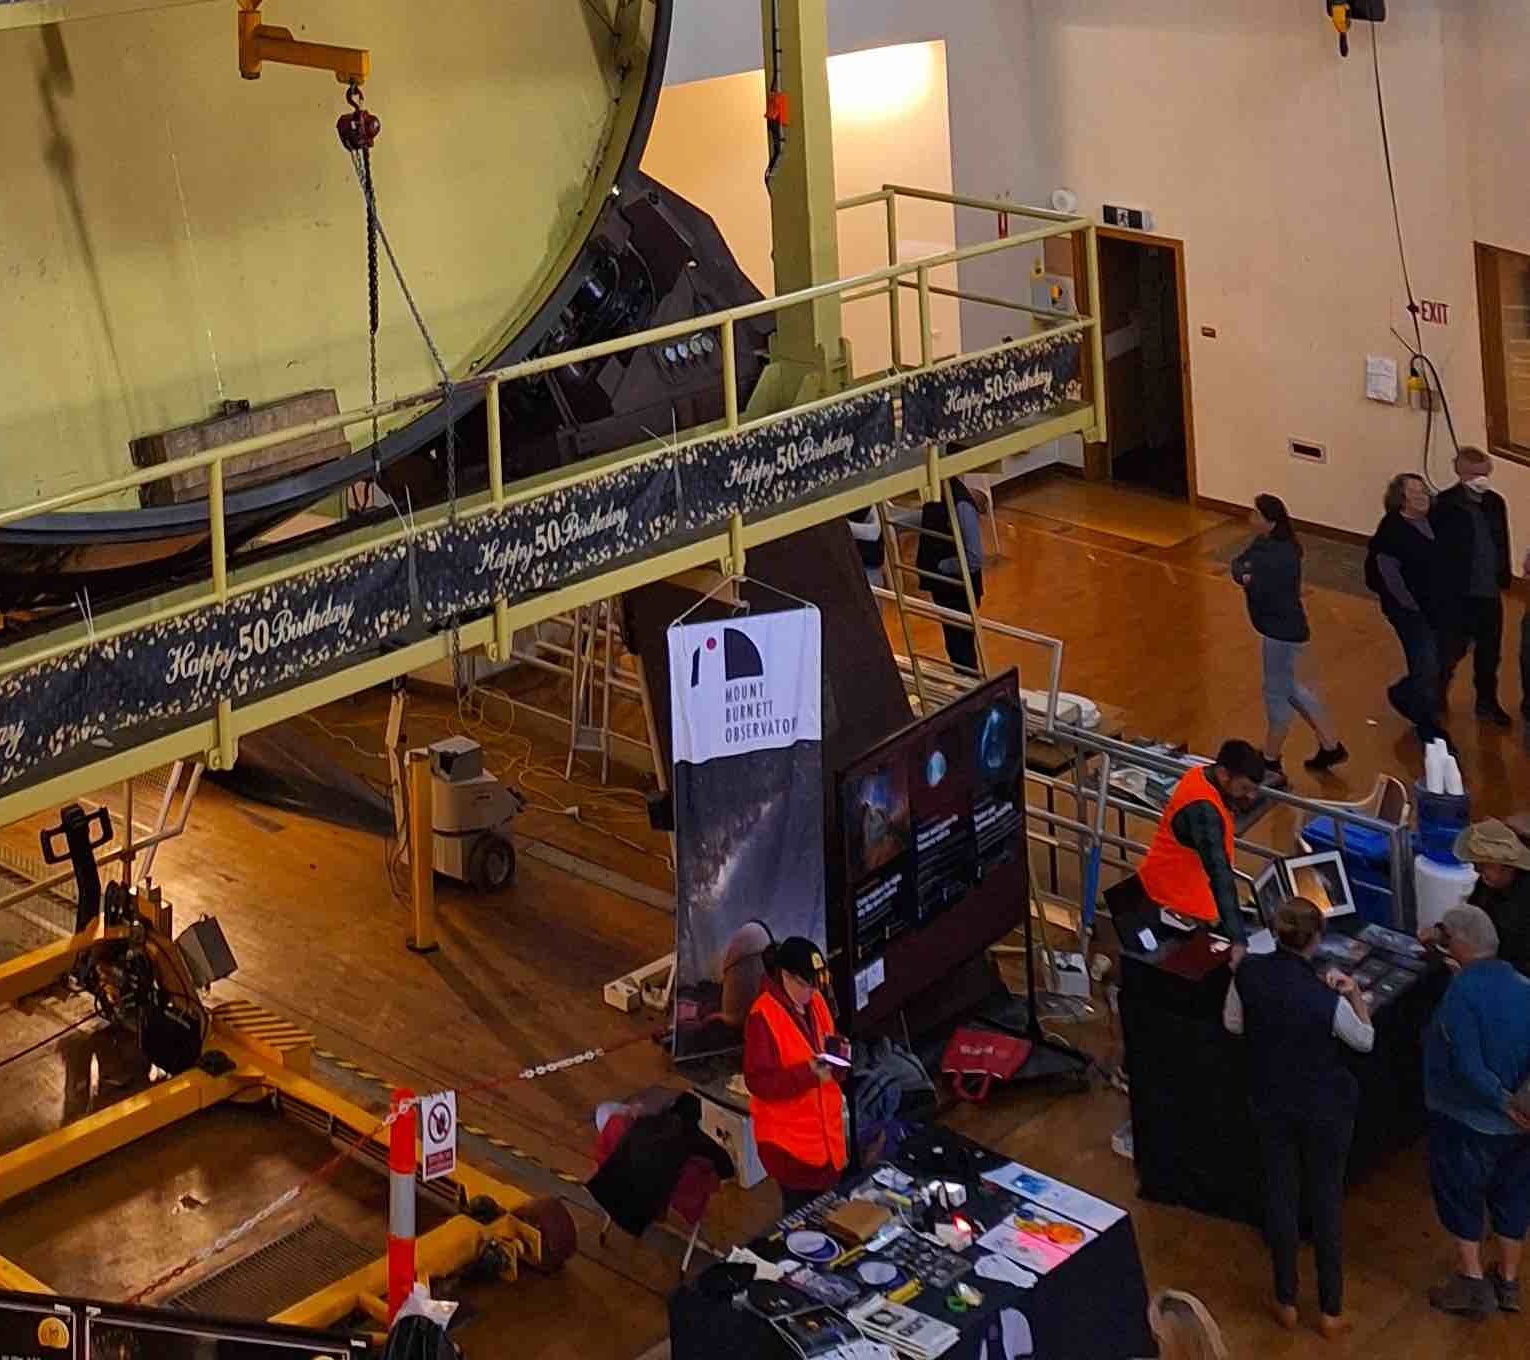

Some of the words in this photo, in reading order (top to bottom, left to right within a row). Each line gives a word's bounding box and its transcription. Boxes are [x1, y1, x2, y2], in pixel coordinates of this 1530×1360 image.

[1421, 300, 1449, 324] EXIT
[943, 384, 984, 420] Happy
[984, 374, 1003, 404] 50
[724, 456, 776, 494] Happy
[776, 442, 798, 475] 50
[798, 427, 855, 467] Birthday
[474, 537, 534, 580] Happy
[535, 519, 561, 557] 50
[561, 499, 629, 546] Birthday
[165, 641, 238, 689] Happy
[238, 618, 269, 662] 50
[270, 593, 355, 648] Birthday
[725, 682, 763, 703] MOUNT
[725, 700, 773, 723] BURNETT
